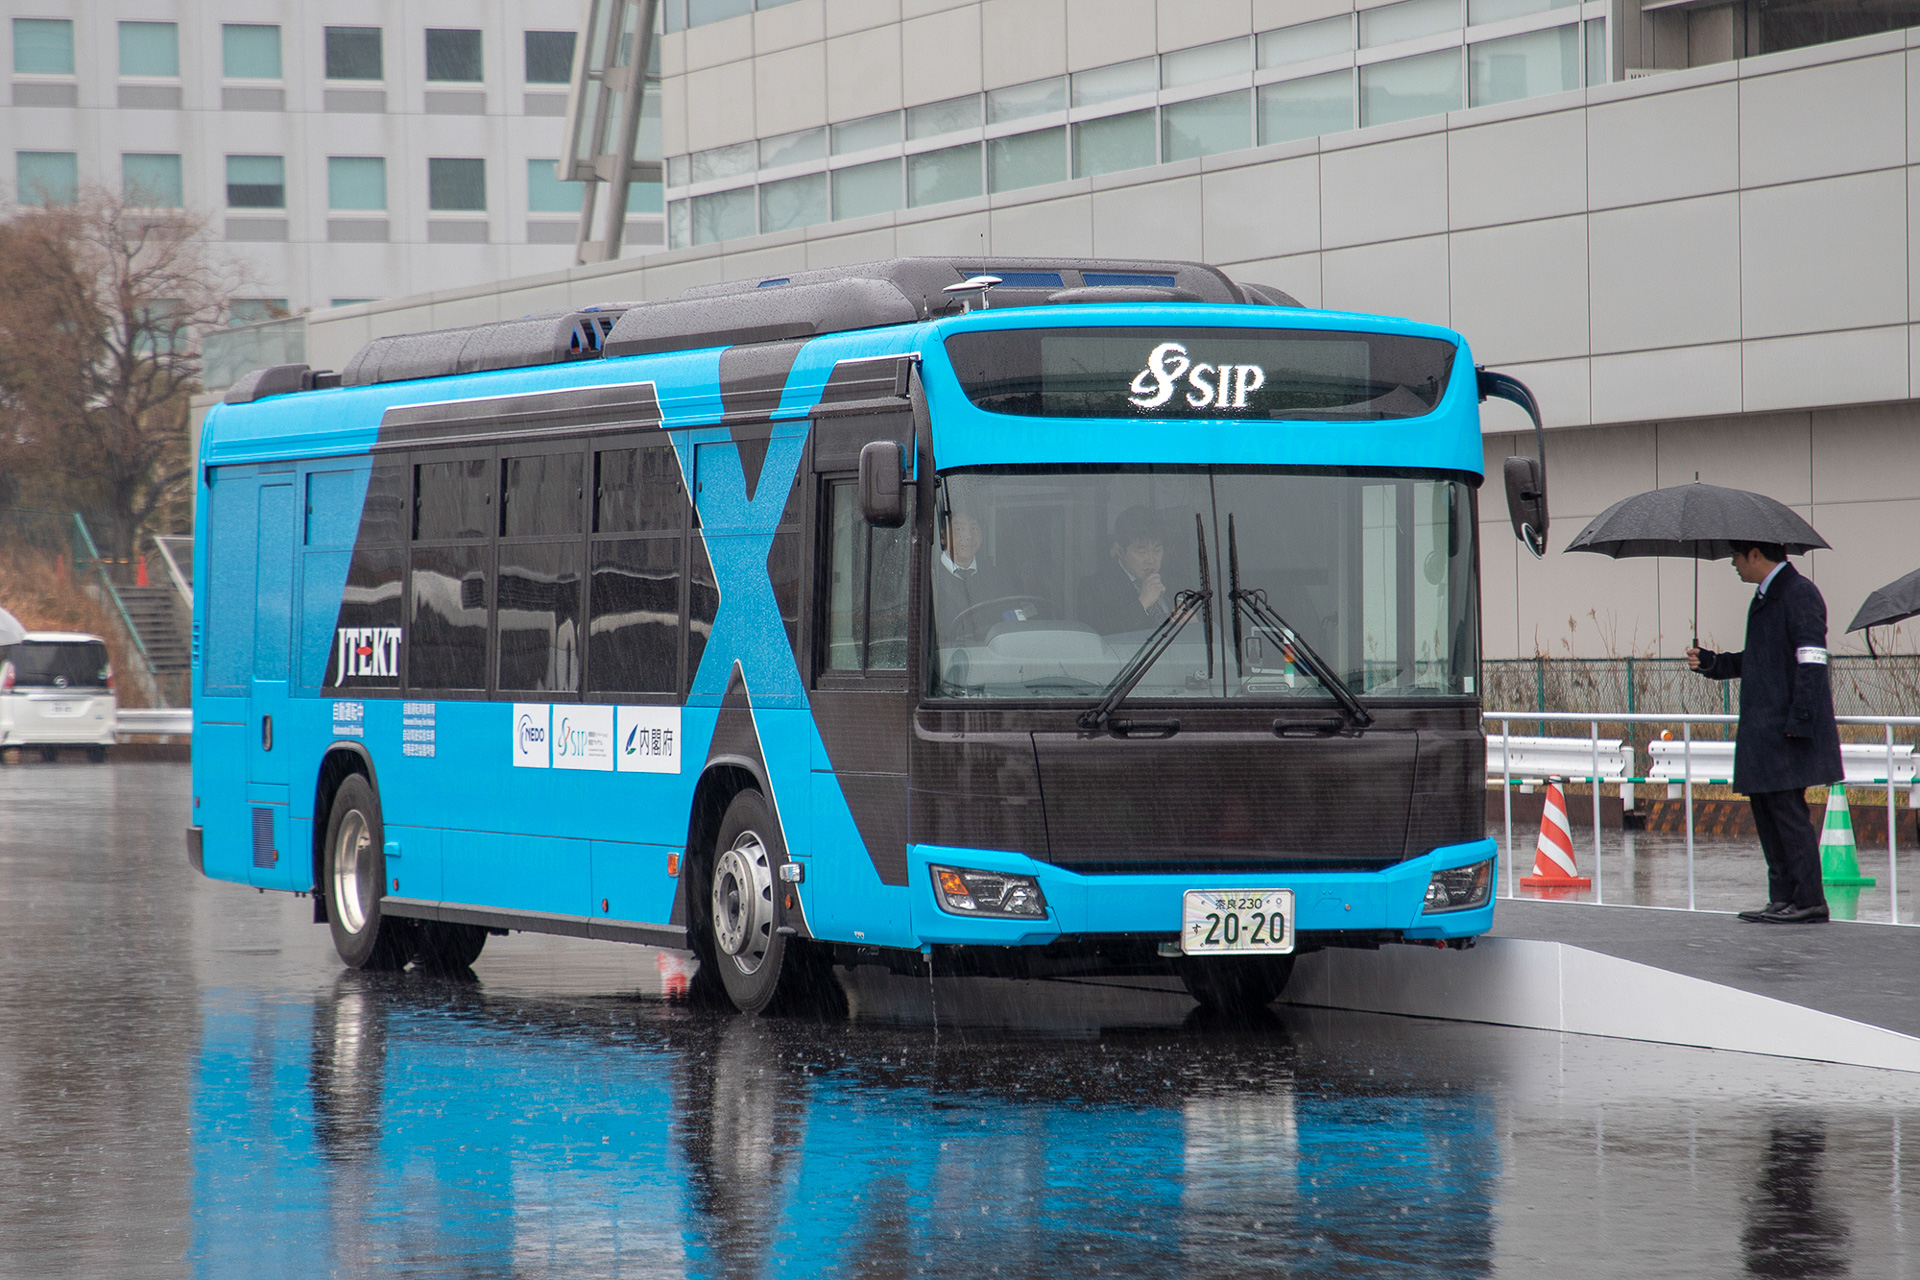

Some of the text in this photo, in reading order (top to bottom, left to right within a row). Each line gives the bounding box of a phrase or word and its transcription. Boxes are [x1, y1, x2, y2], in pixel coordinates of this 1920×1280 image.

[1186, 363, 1266, 407] SIP
[334, 628, 402, 687] JTEKT
[525, 728, 545, 742] NEDO
[571, 731, 588, 757] SIP
[639, 727, 674, 757] 内閣府
[1192, 912, 1284, 944] す 20-20
